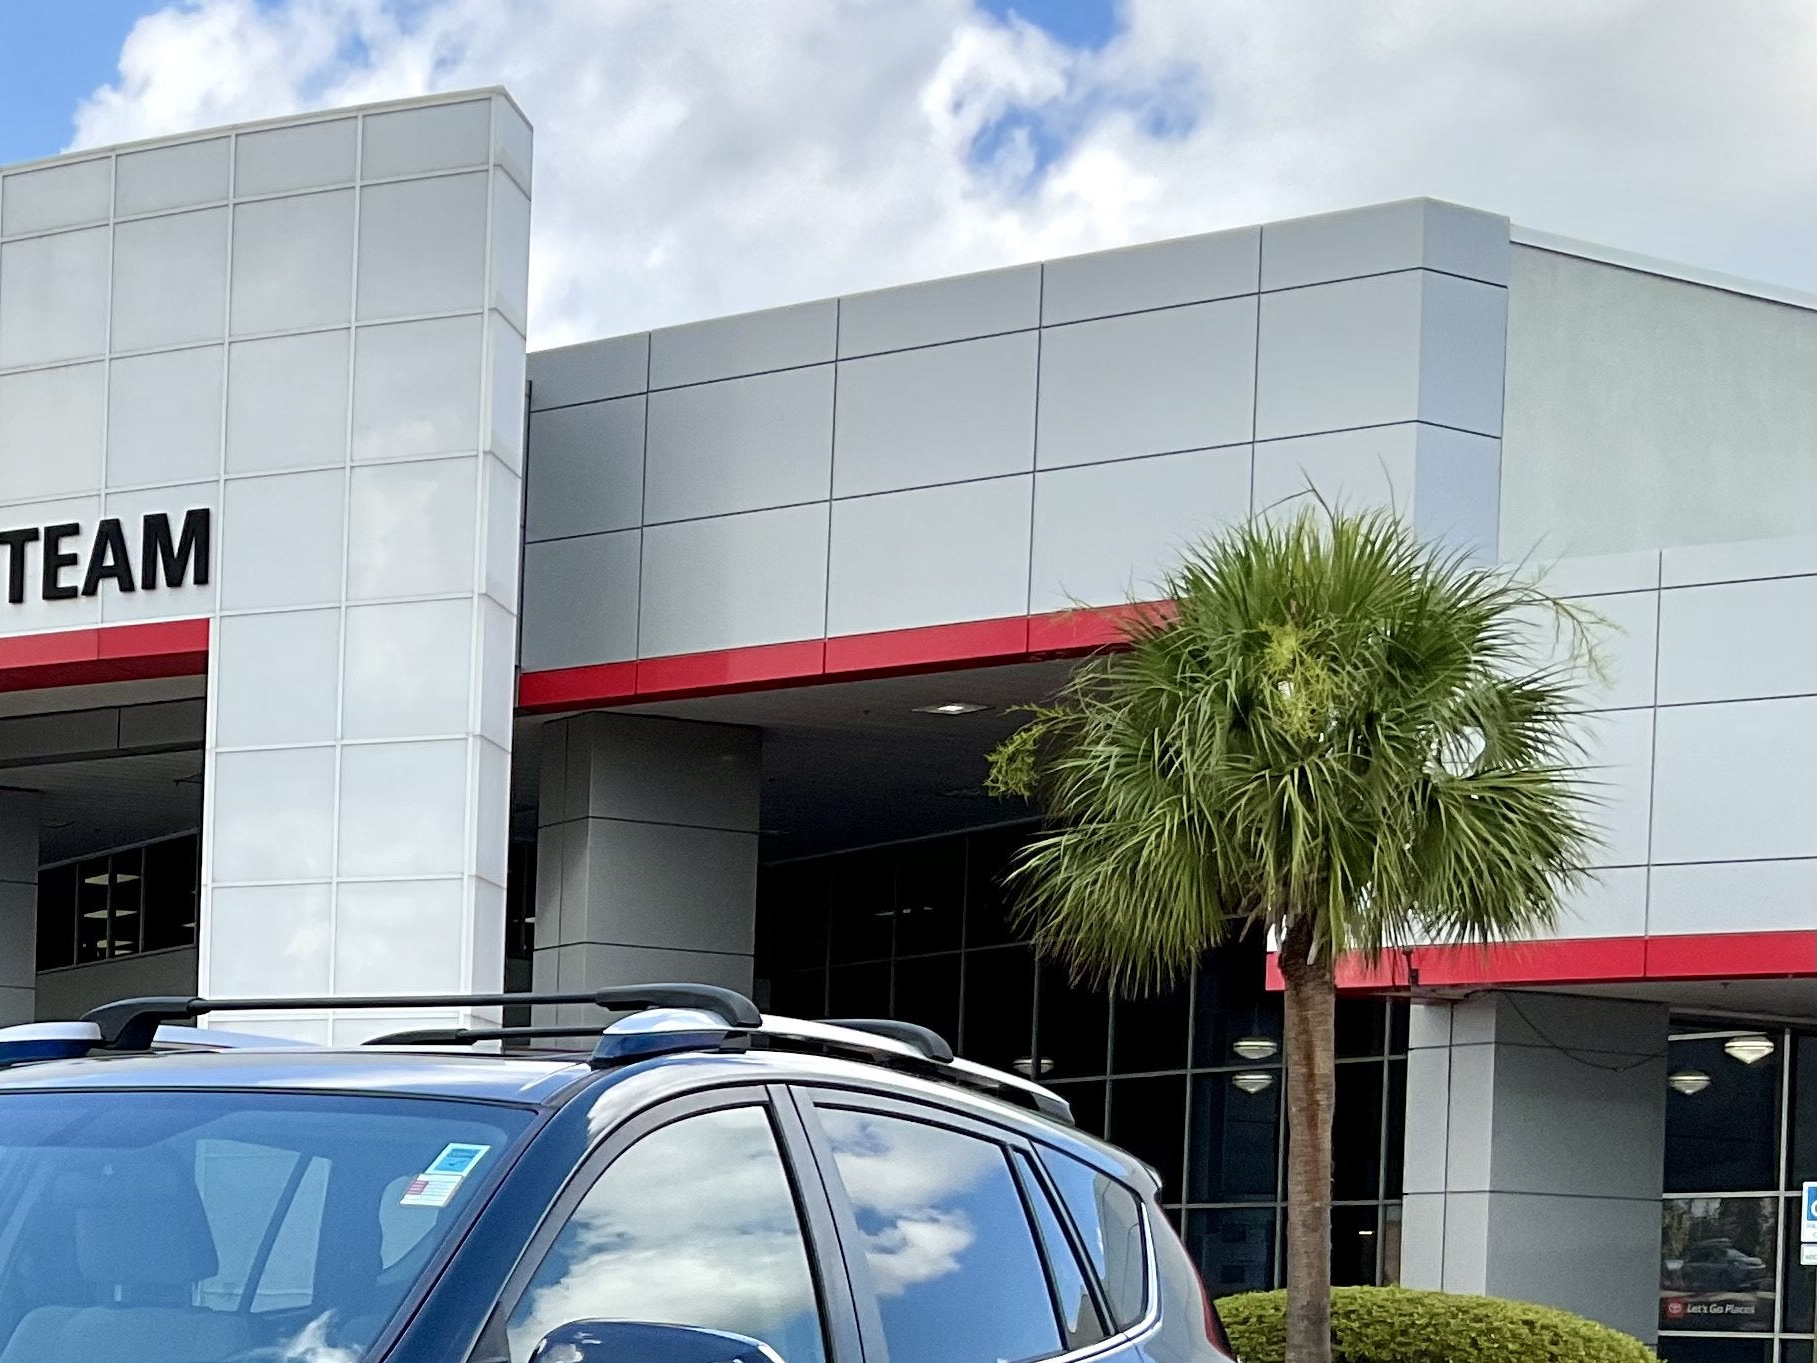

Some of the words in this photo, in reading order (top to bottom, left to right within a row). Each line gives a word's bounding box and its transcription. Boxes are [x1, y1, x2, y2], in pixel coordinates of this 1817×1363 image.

[1687, 1304, 1708, 1314] Let's
[1709, 1303, 1723, 1314] Go
[1725, 1304, 1756, 1314] Places
